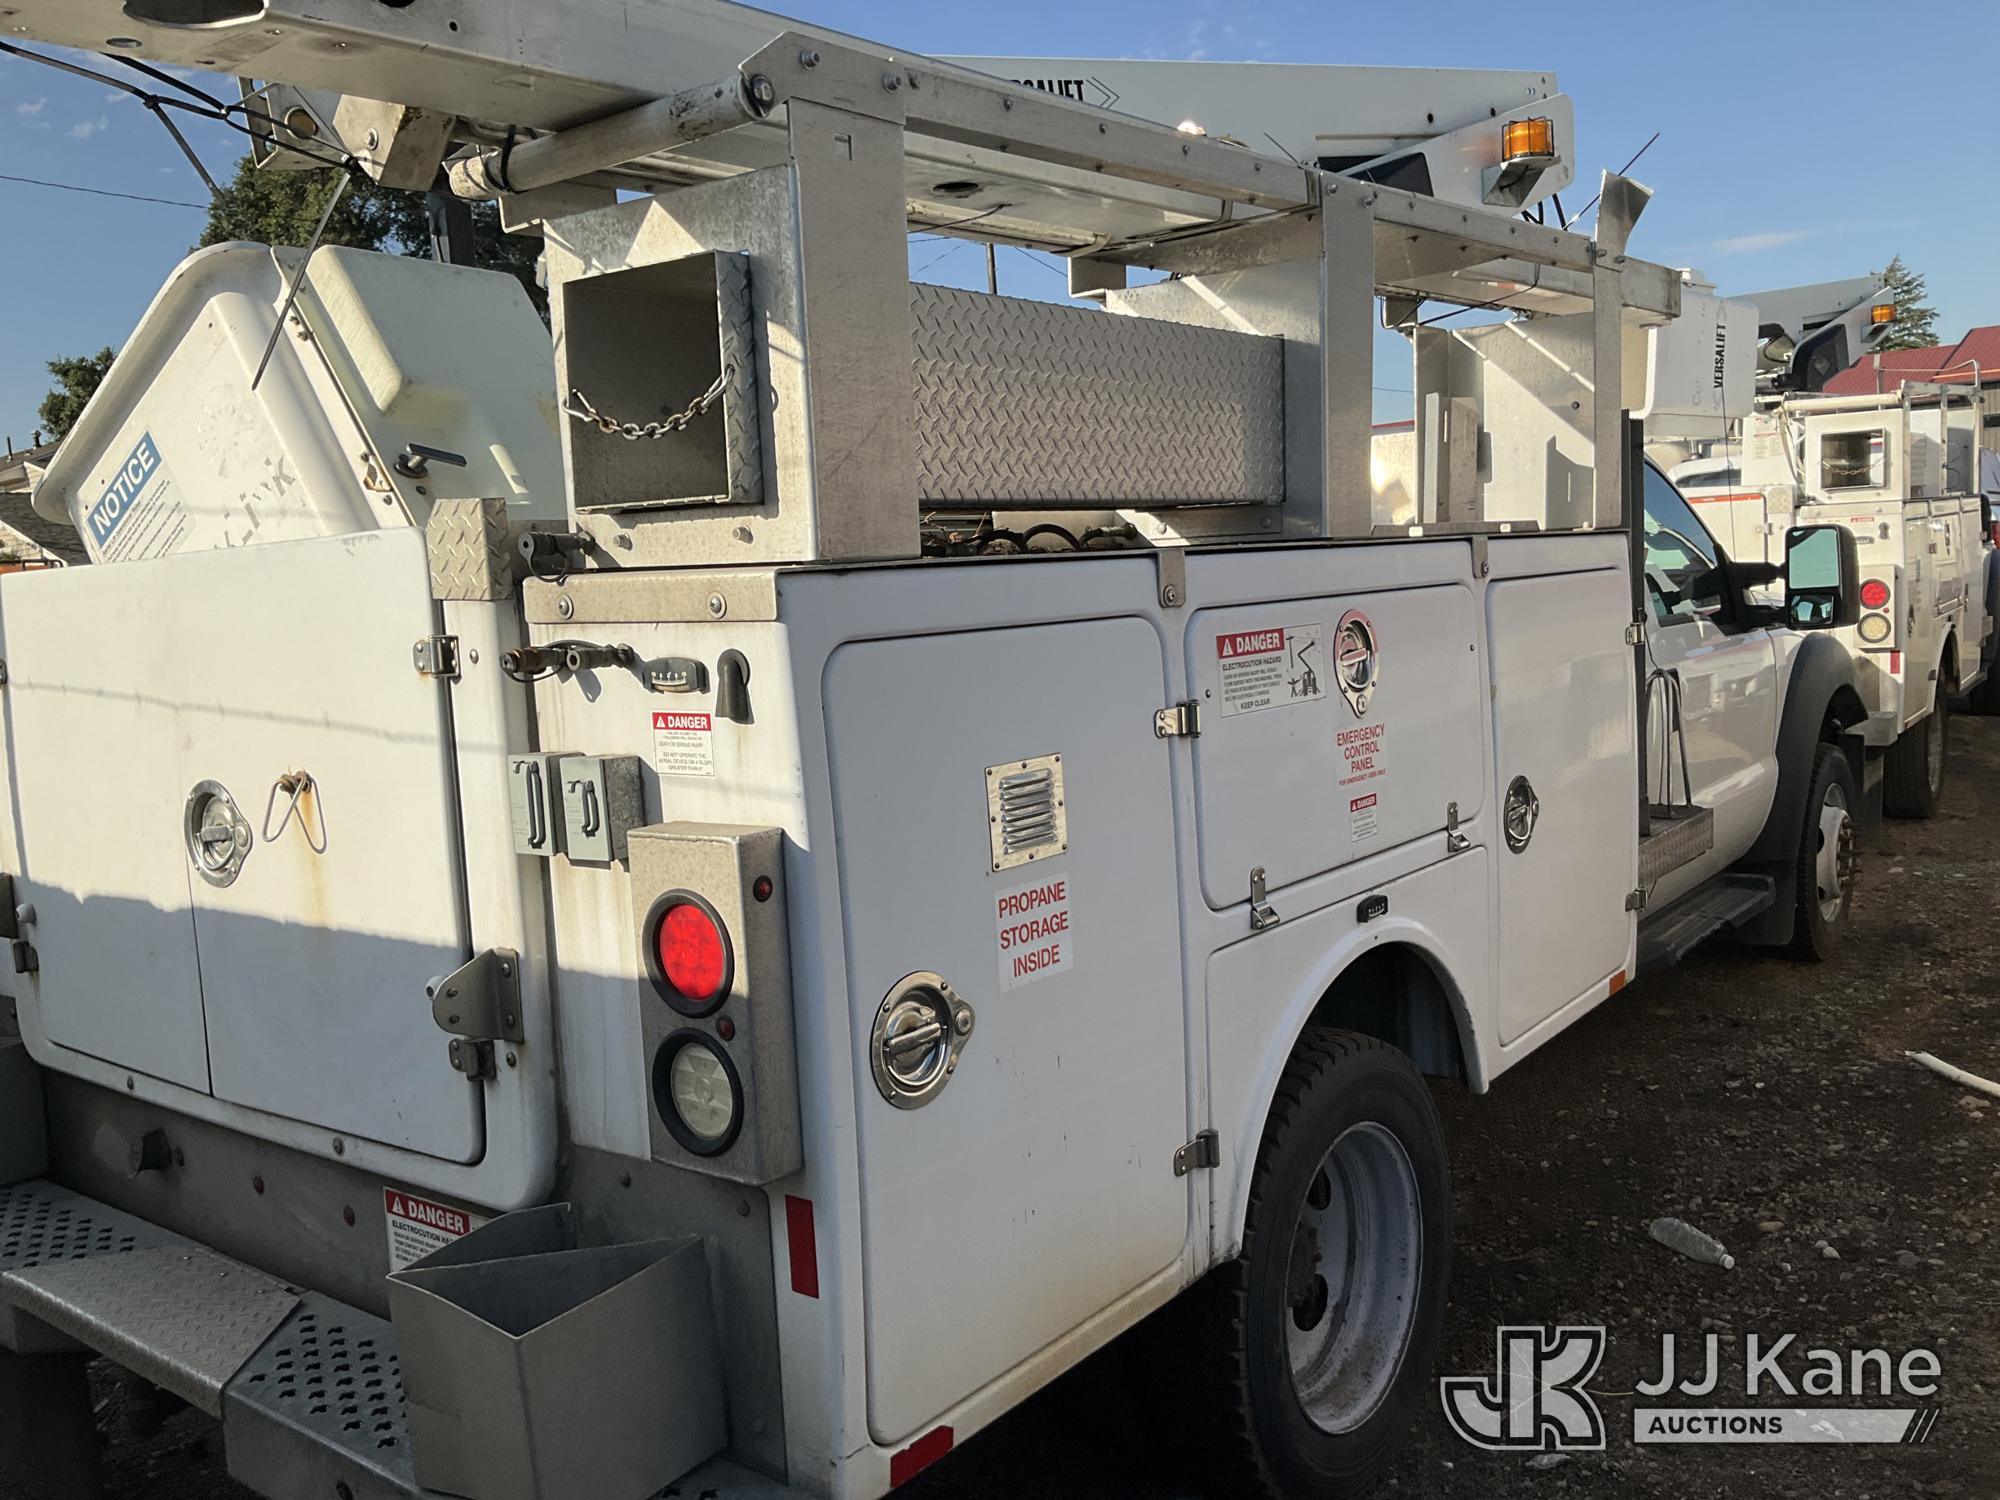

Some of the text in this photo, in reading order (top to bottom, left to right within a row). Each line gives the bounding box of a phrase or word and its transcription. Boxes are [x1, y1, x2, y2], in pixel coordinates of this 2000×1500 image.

[1713, 323, 1726, 389] VERSALIFT
[93, 442, 154, 536] NOTICE
[1236, 632, 1281, 653] DANGER
[1222, 656, 1282, 671] ELECTROCUTION HAZARD
[1240, 697, 1271, 710] KEEP CLEAR
[667, 715, 708, 729] DANGER
[1337, 723, 1385, 746] EMERGENCY
[1344, 740, 1380, 760] CONTROL
[1351, 757, 1375, 773] PANEL
[1356, 796, 1376, 809] DANGER
[998, 881, 1066, 918] PROPANE
[1000, 911, 1069, 950] STORAGE
[1013, 944, 1061, 978] INSIDE
[408, 1200, 465, 1233] DANGER
[392, 1220, 441, 1242] ELECTROCUTION
